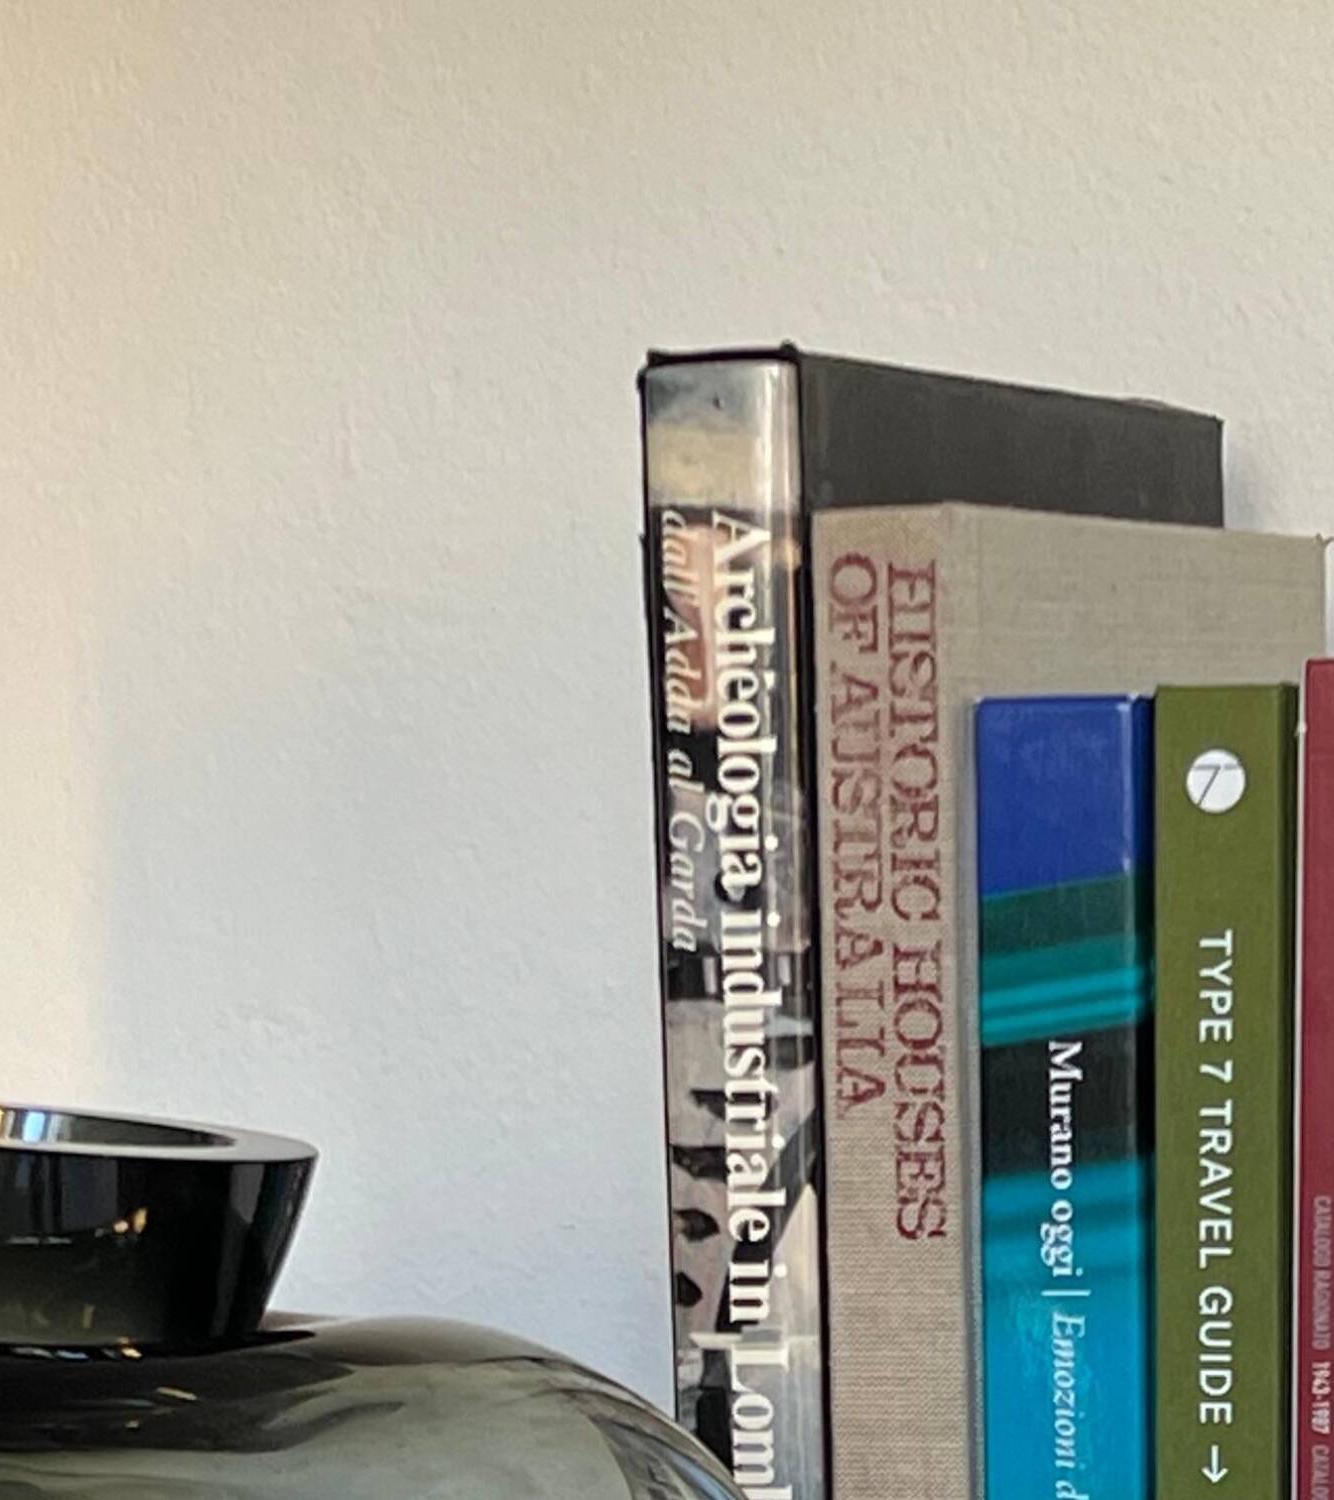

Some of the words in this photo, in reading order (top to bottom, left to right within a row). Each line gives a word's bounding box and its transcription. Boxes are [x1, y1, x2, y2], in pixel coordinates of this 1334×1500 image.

[663, 607, 706, 734] Adda
[827, 549, 881, 654] OF
[668, 749, 705, 792] al
[707, 510, 778, 901] Archeologia
[884, 558, 943, 922] HISTORIC
[668, 811, 707, 953] Garda
[829, 661, 887, 1120] AUSTRALIA
[1198, 929, 1233, 1043] TYPE
[720, 910, 787, 1242] industriale
[891, 942, 950, 1242] HOUSES
[1048, 1040, 1083, 1190] Murano
[1198, 1060, 1233, 1084] 7
[1040, 1200, 1083, 1278] oggi
[1198, 1099, 1233, 1269] TRAVEL
[728, 1263, 788, 1323] in
[1198, 1286, 1233, 1425] GUIDE
[1051, 1311, 1087, 1469] Emozioni
